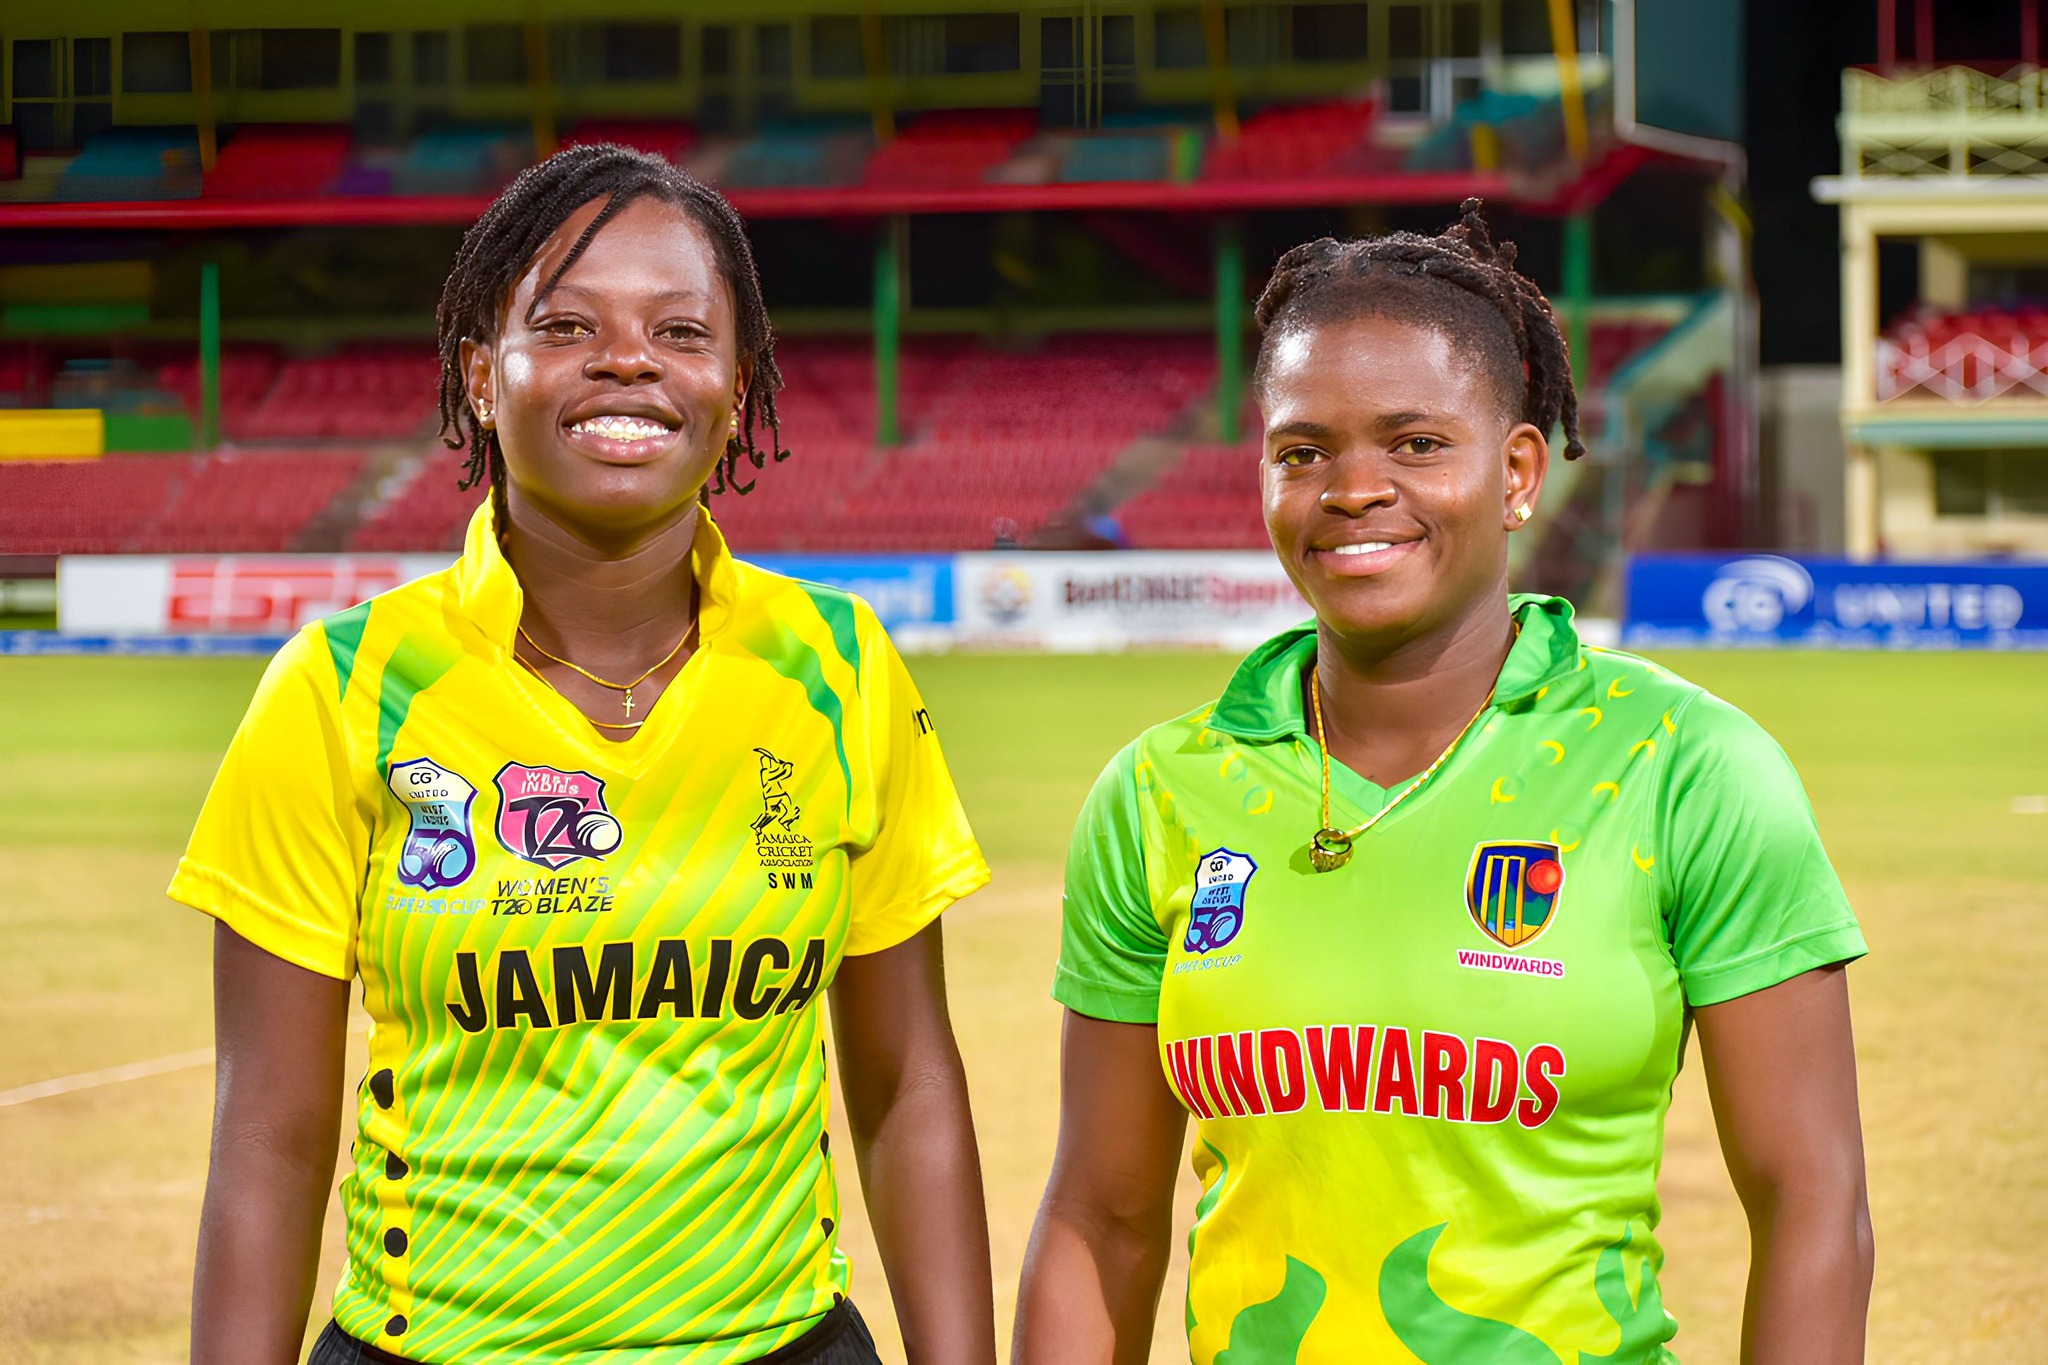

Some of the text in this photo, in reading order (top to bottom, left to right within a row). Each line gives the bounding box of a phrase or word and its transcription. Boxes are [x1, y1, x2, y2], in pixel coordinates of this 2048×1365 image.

[1834, 583, 2024, 630] UNITED
[410, 772, 432, 785] CG
[509, 797, 623, 861] T20
[756, 833, 812, 845] JAMAICA
[757, 846, 814, 857] CRICKET
[498, 877, 610, 897] WOMEN'S
[536, 896, 615, 913] BLAZE
[1458, 951, 1563, 977] WINDWARDS
[446, 938, 825, 1033] JAMAICA
[1166, 1024, 1566, 1129] WINDWARDS
